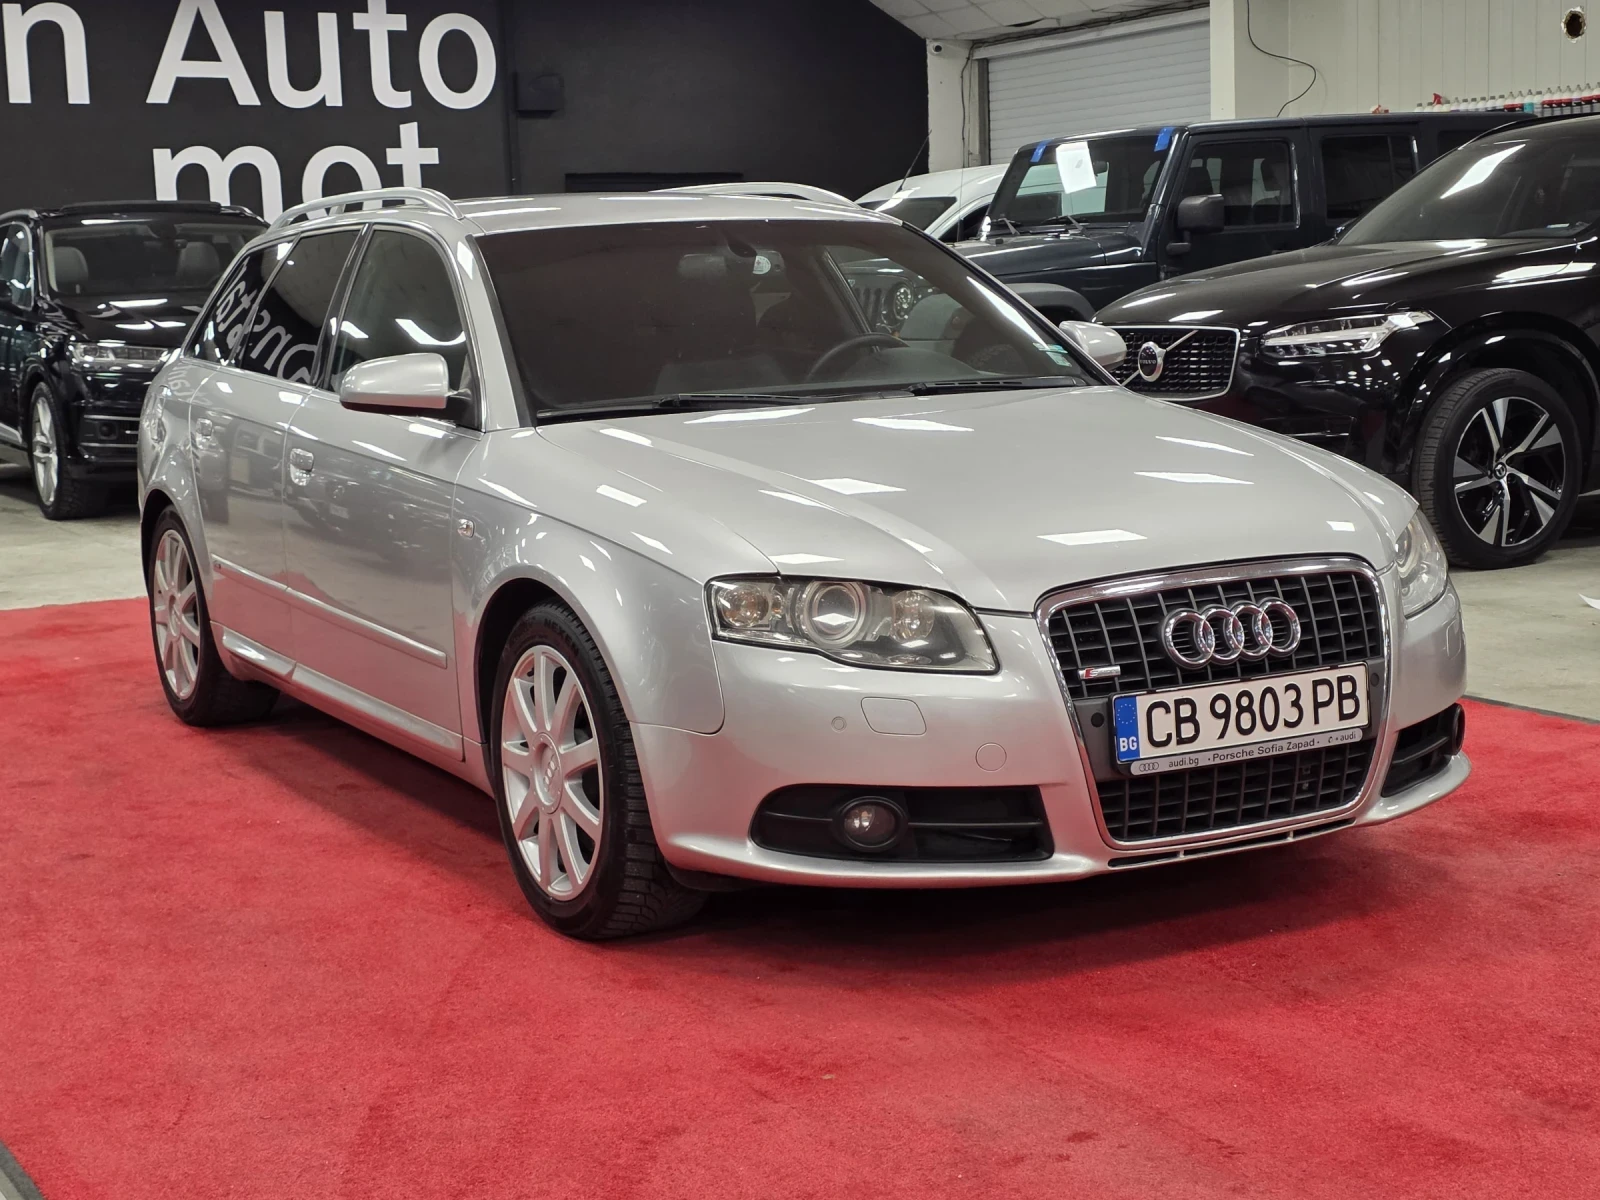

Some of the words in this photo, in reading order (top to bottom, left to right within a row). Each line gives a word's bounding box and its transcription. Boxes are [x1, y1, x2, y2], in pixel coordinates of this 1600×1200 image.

[145, 0, 497, 109] Auto
[544, 618, 580, 657] NEXEN
[1146, 696, 1201, 748] CB
[1209, 682, 1302, 740] 9803
[1312, 674, 1361, 725] PB
[1119, 736, 1137, 752] BG
[1168, 756, 1199, 768] audi.bg
[1212, 748, 1255, 762] Porsche
[1257, 743, 1284, 755] Sofia
[1286, 738, 1315, 752] Zapad
[1340, 732, 1356, 741] audi
